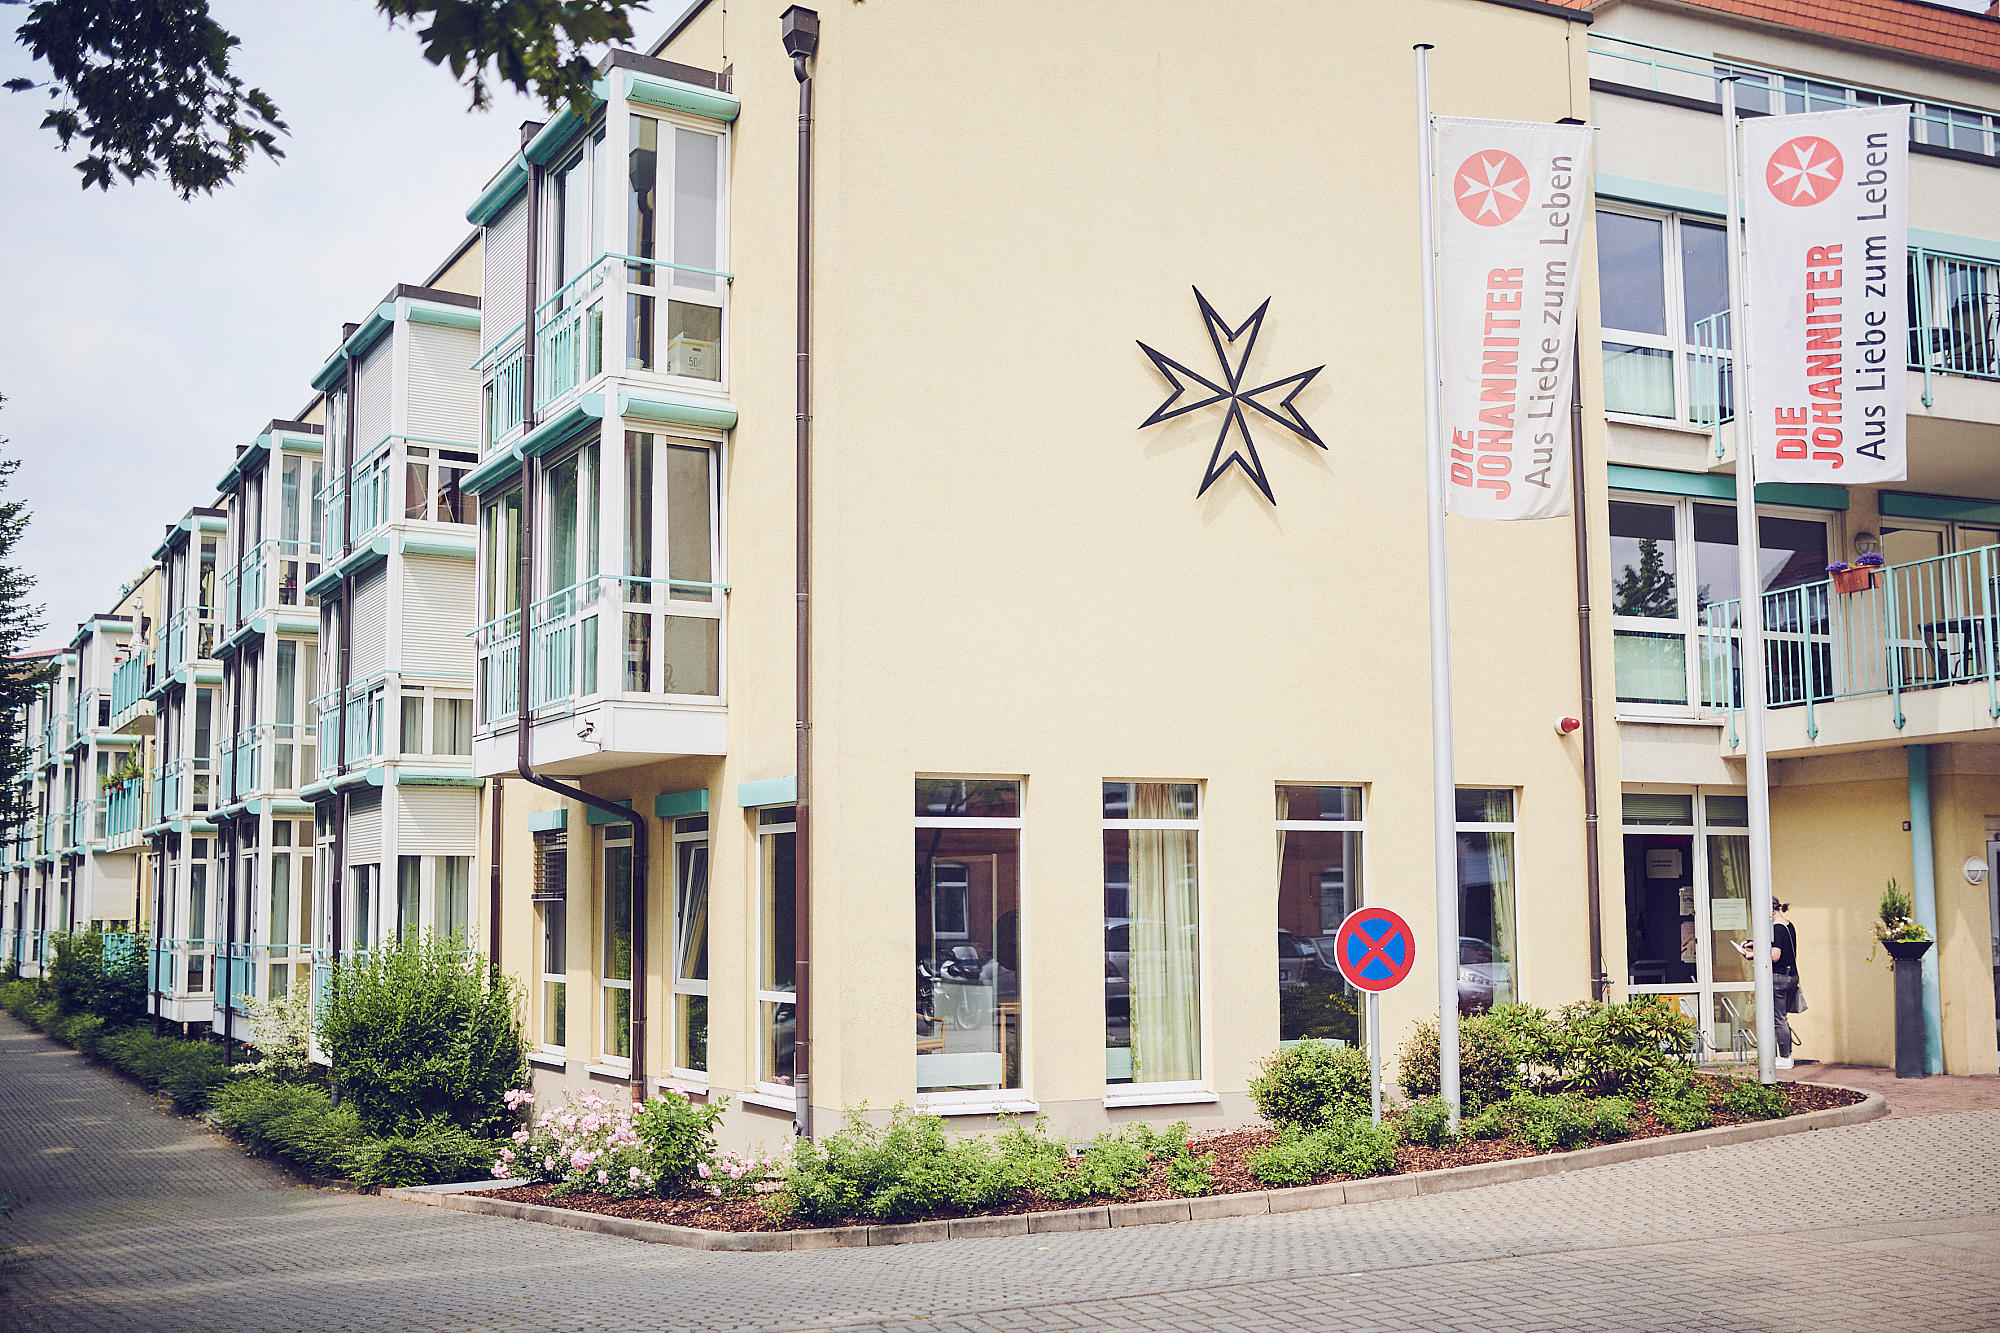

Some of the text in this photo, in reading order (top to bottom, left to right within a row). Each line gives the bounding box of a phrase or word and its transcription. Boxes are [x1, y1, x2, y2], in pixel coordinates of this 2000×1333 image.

[1476, 267, 1524, 500] JOHANNITER
[1524, 156, 1573, 489] Aus Liebe zum Leben
[1806, 243, 1844, 470] JOHANNITER
[1855, 132, 1888, 461] Aus Liebe zum Leben
[1450, 426, 1475, 488] DIE
[1774, 406, 1808, 460] DIE
